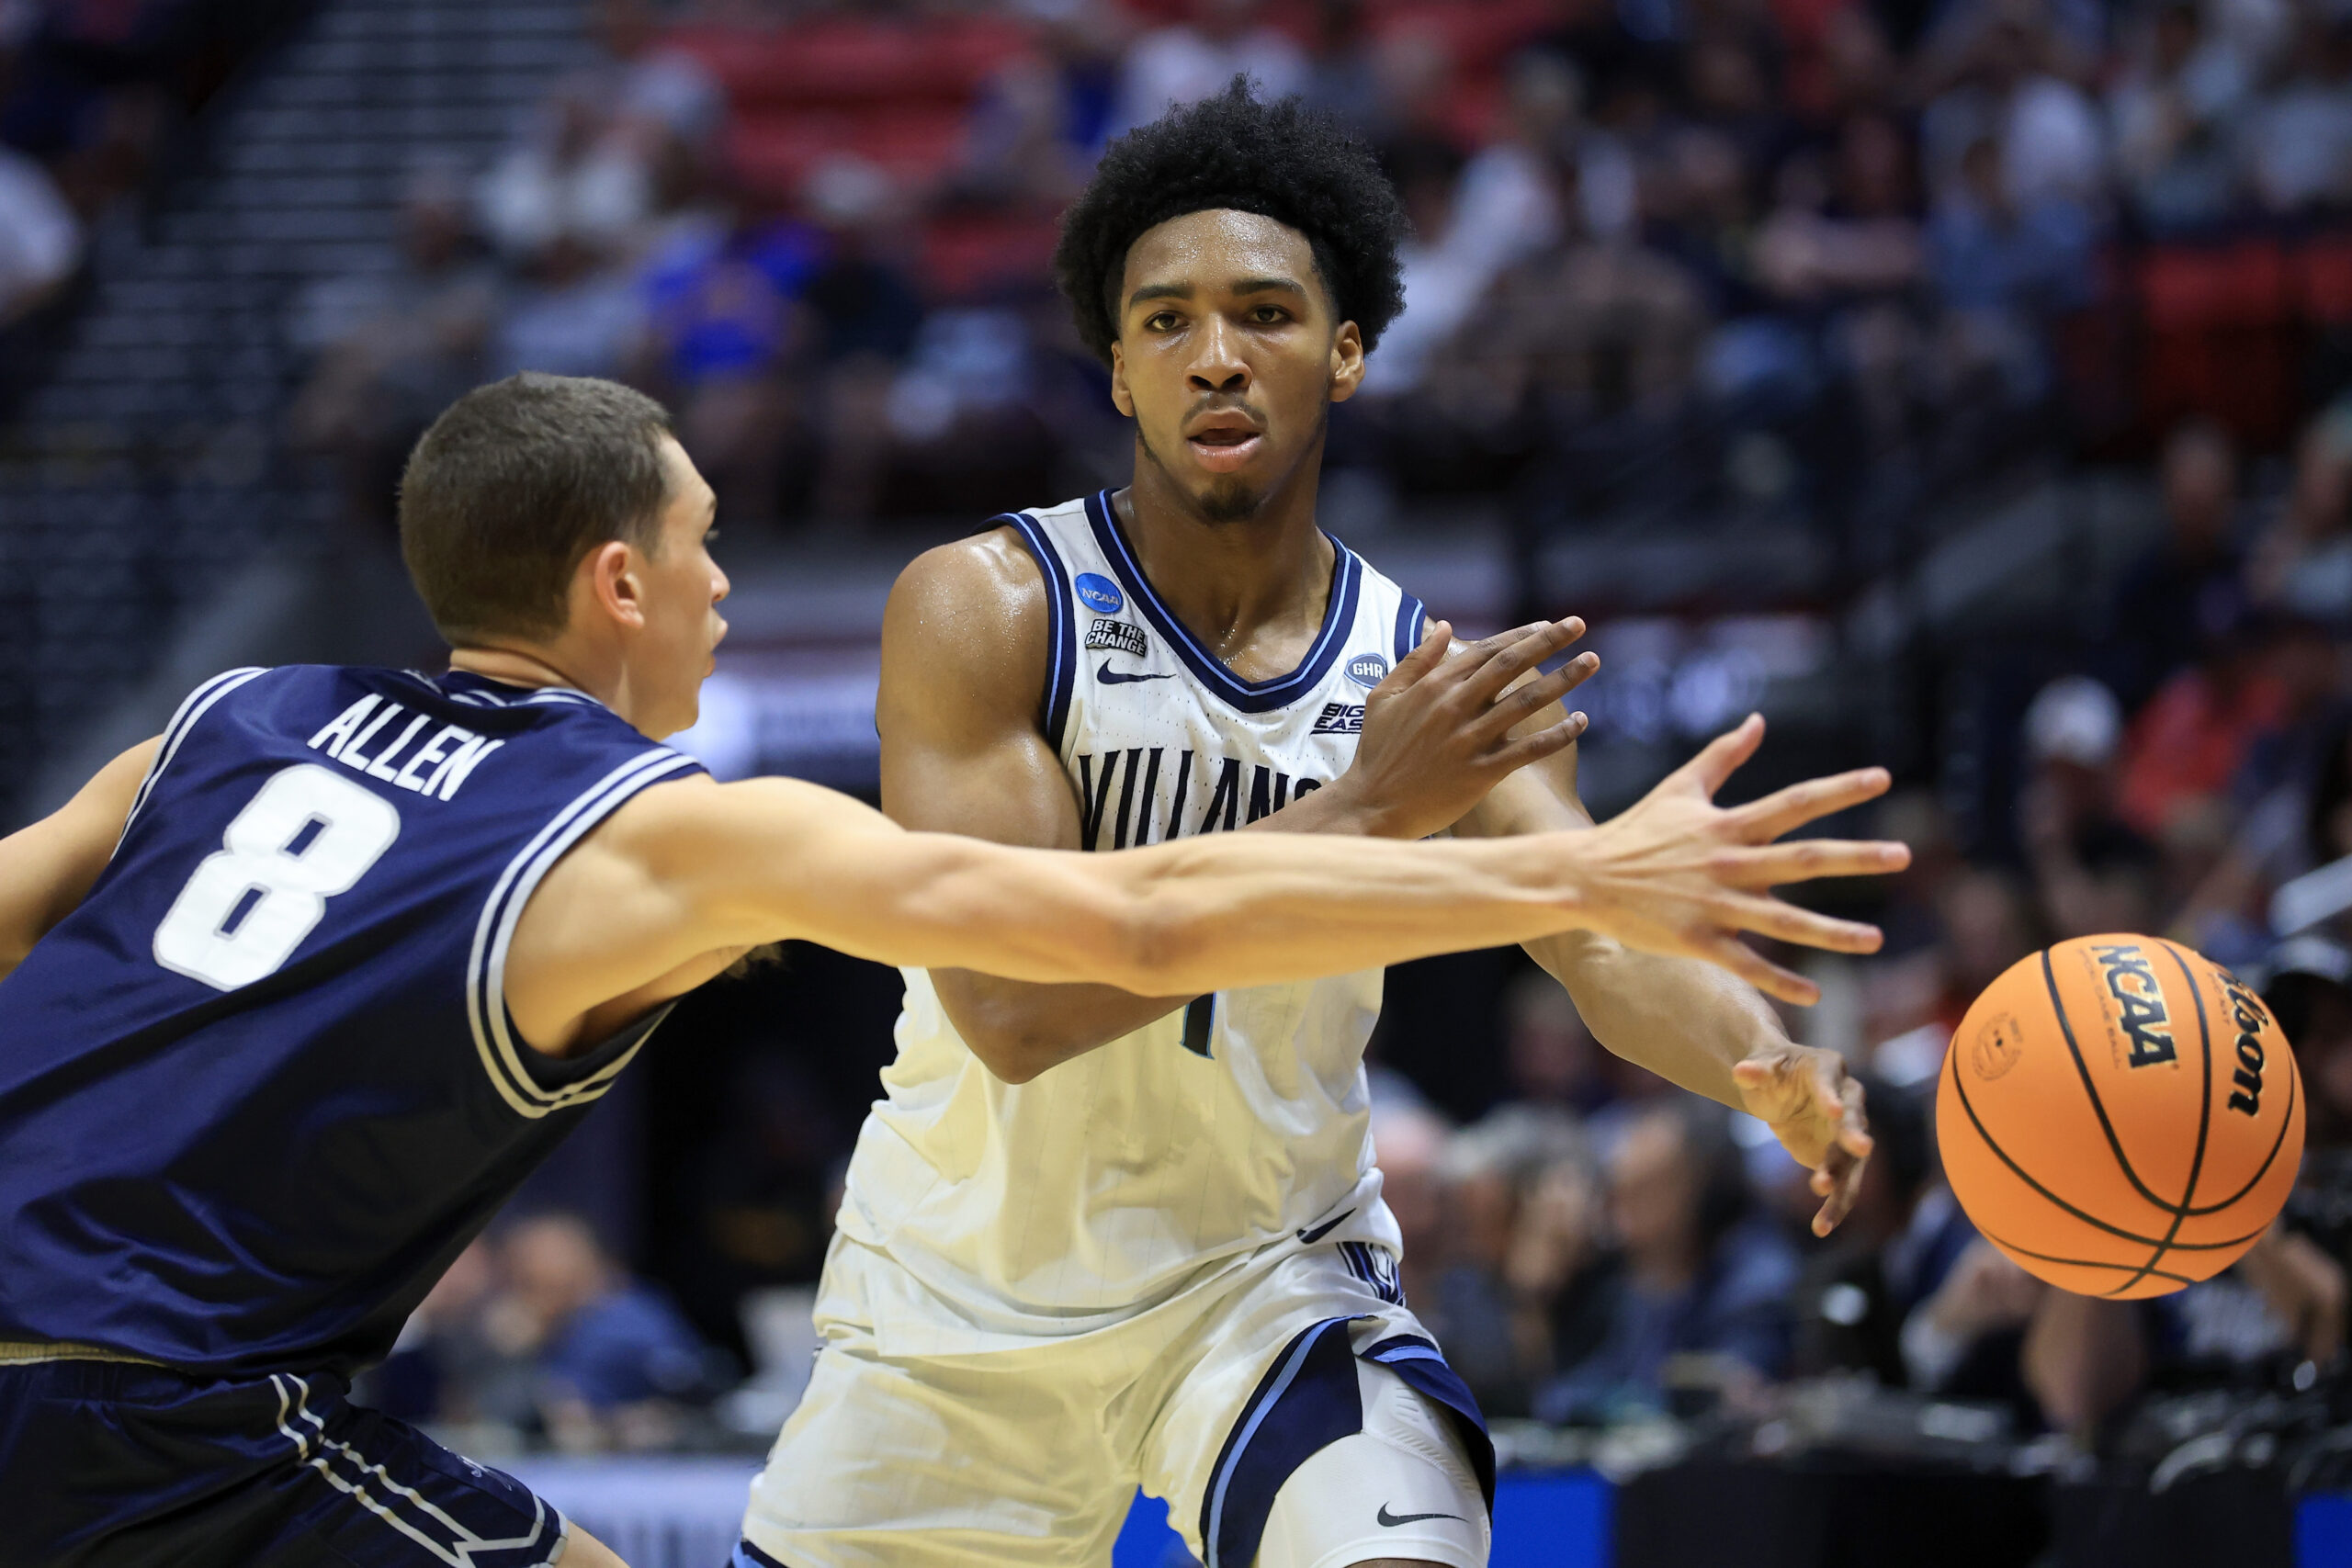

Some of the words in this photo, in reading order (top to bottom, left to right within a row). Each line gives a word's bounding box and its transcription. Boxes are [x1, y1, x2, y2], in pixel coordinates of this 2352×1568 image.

[1081, 587, 1120, 606] NCAA
[1091, 619, 1114, 633] BE
[1119, 624, 1145, 642] THE
[1085, 631, 1147, 656] CHANGE
[1352, 662, 1384, 680] GHR
[1321, 703, 1365, 717] BIG
[1314, 716, 1363, 730] EAS
[307, 693, 505, 802] ALLEN
[153, 762, 401, 993] 8
[2090, 946, 2177, 1068] NCAA
